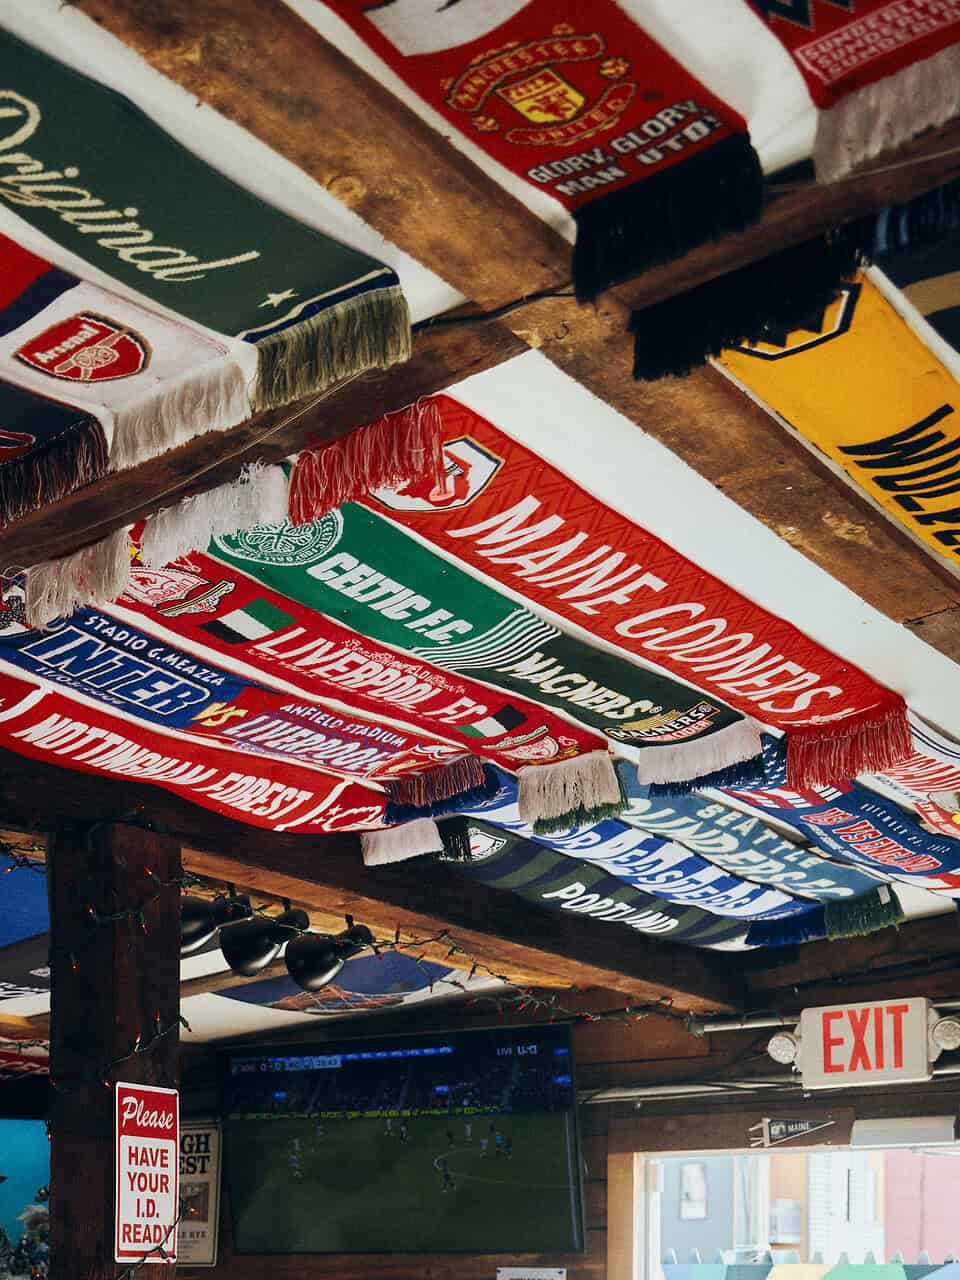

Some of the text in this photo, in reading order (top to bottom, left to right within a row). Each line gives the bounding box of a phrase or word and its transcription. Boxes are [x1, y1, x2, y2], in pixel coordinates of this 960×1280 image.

[454, 37, 596, 107] MANCHESTER
[525, 97, 628, 143] UNITED
[554, 165, 628, 197] MAN
[447, 495, 668, 617] MAINE
[306, 552, 433, 621] CELTIC
[84, 615, 149, 650] STADIO
[18, 623, 212, 716] INTER
[253, 626, 442, 713] LIVERPOOL
[421, 695, 489, 724] FC
[496, 651, 655, 720] MAGNERS
[221, 711, 404, 773] LIVERPOOL
[280, 703, 344, 730] ANFIELD
[341, 723, 409, 748] STADIUM
[612, 706, 704, 740] MAGNERS
[205, 771, 315, 821] FOREST
[695, 803, 825, 870] SEATTLE
[832, 818, 883, 843] VS
[849, 835, 943, 873] ENGLAND
[822, 1004, 910, 1075] EXIT
[122, 1095, 173, 1129] Please
[128, 1146, 169, 1169] HAVE
[127, 1171, 170, 1194] YOUR
[136, 1198, 160, 1218] I.D.
[122, 1222, 173, 1245] READY
